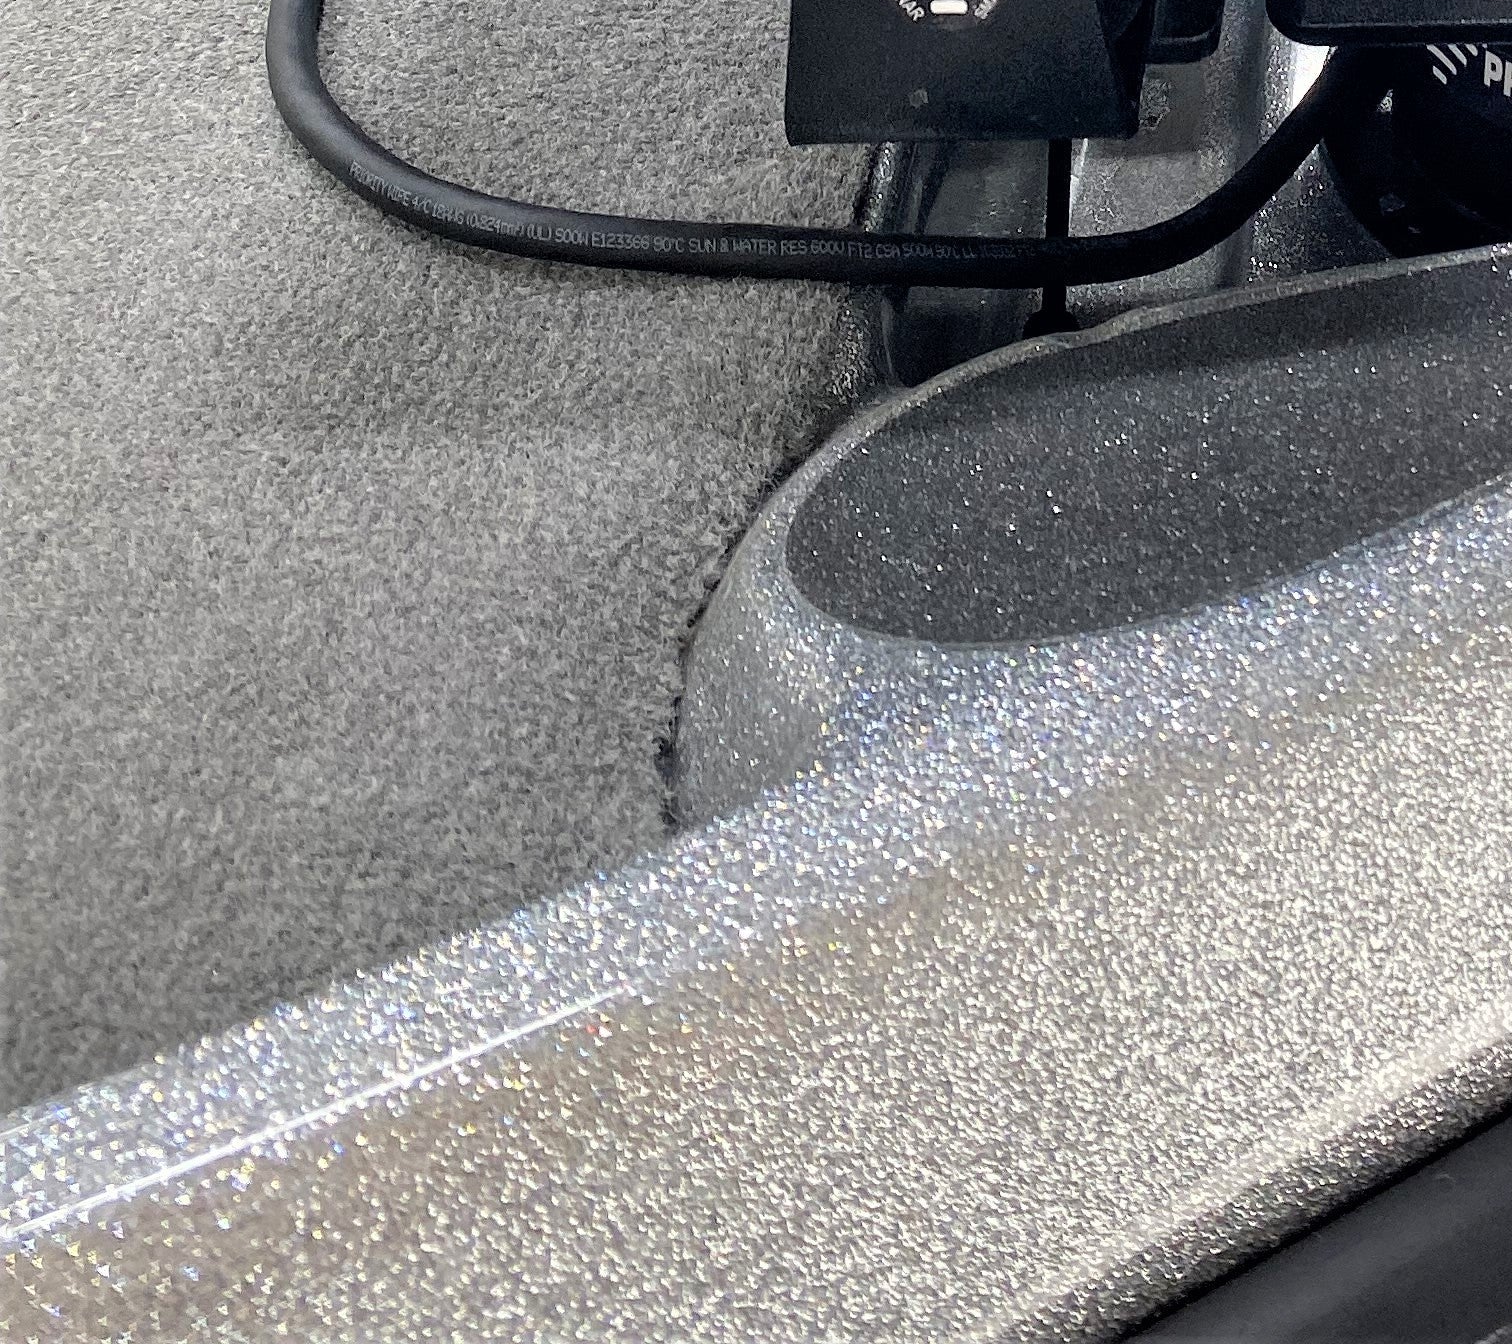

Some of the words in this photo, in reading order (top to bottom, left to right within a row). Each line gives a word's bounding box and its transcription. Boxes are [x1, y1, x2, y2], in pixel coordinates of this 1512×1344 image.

[688, 237, 716, 254] SUN
[732, 238, 777, 255] WATER
[780, 239, 808, 256] RES
